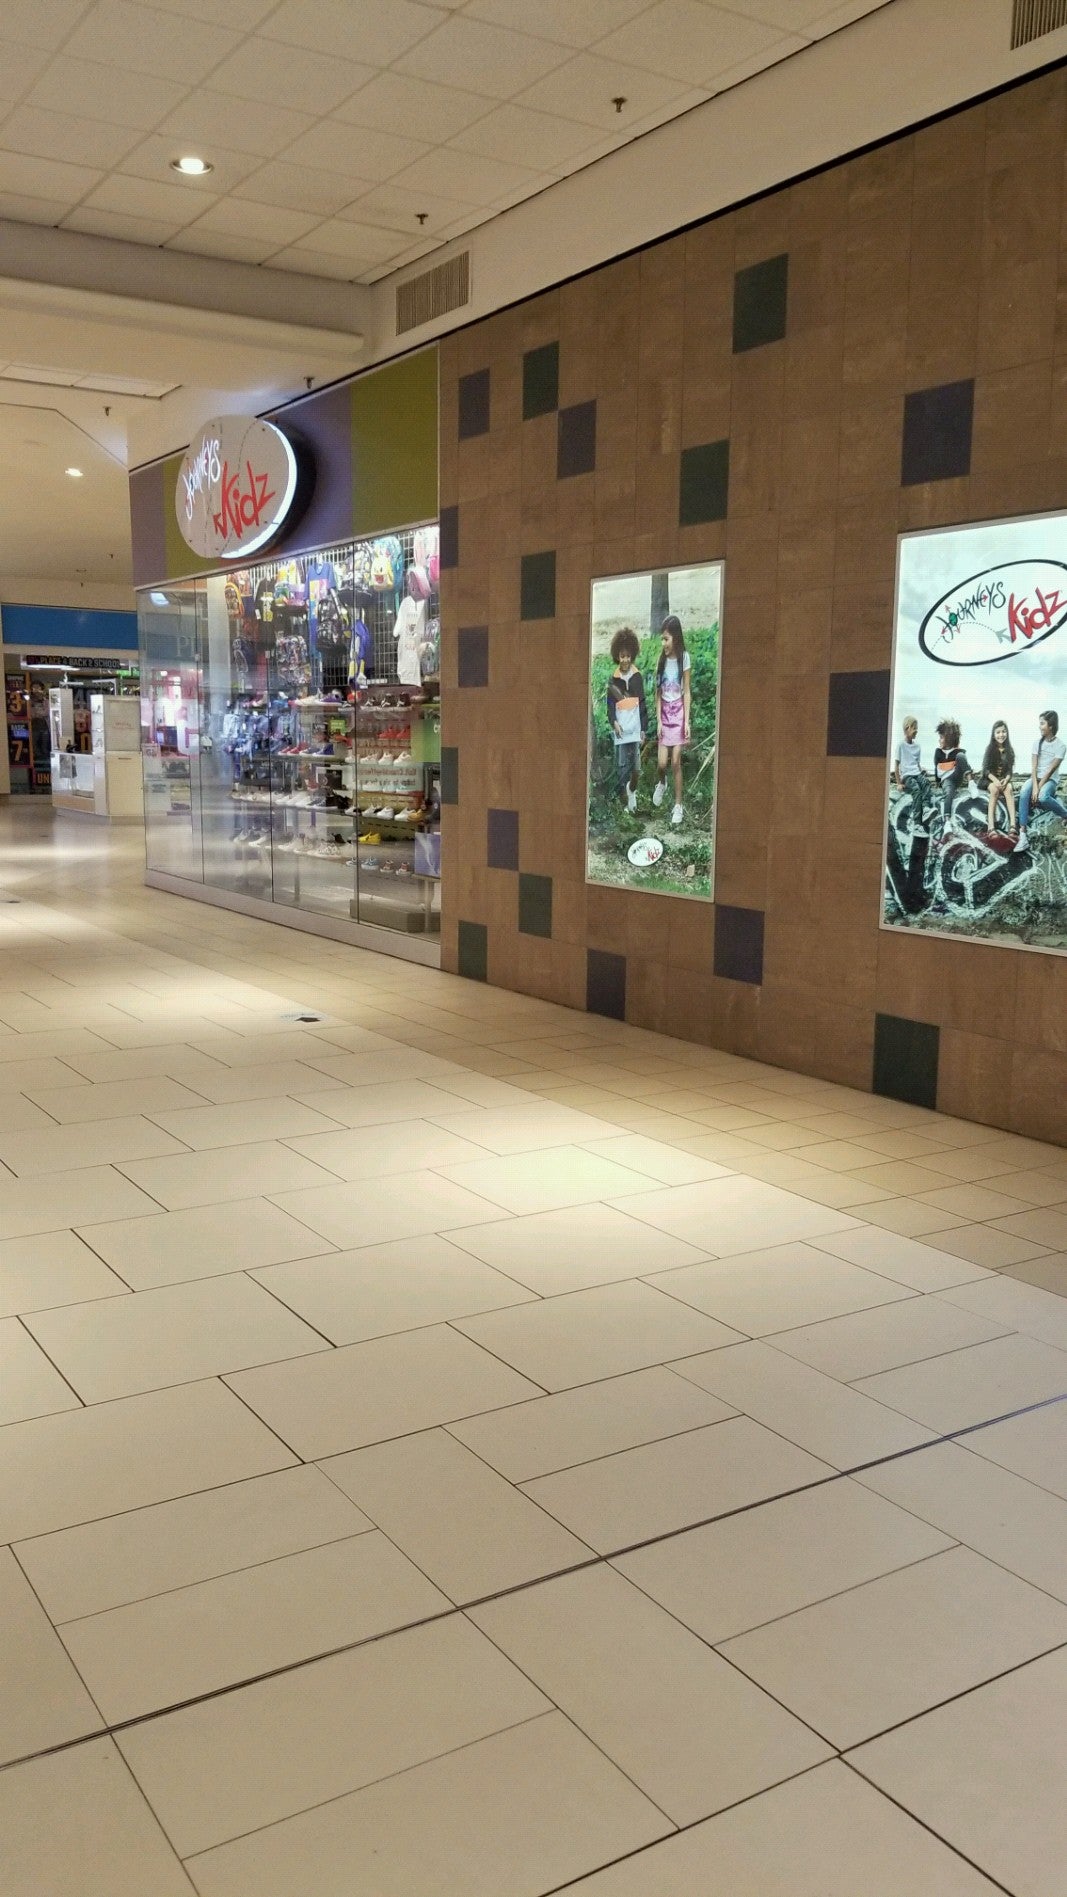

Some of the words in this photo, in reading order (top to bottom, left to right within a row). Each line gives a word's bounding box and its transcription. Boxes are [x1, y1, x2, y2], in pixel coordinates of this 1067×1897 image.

[213, 460, 276, 540] Kidz
[935, 581, 1007, 644] JOURNEYS
[1007, 587, 1067, 643] Kidz
[40, 656, 62, 665] PLACE
[69, 657, 88, 667] BACK
